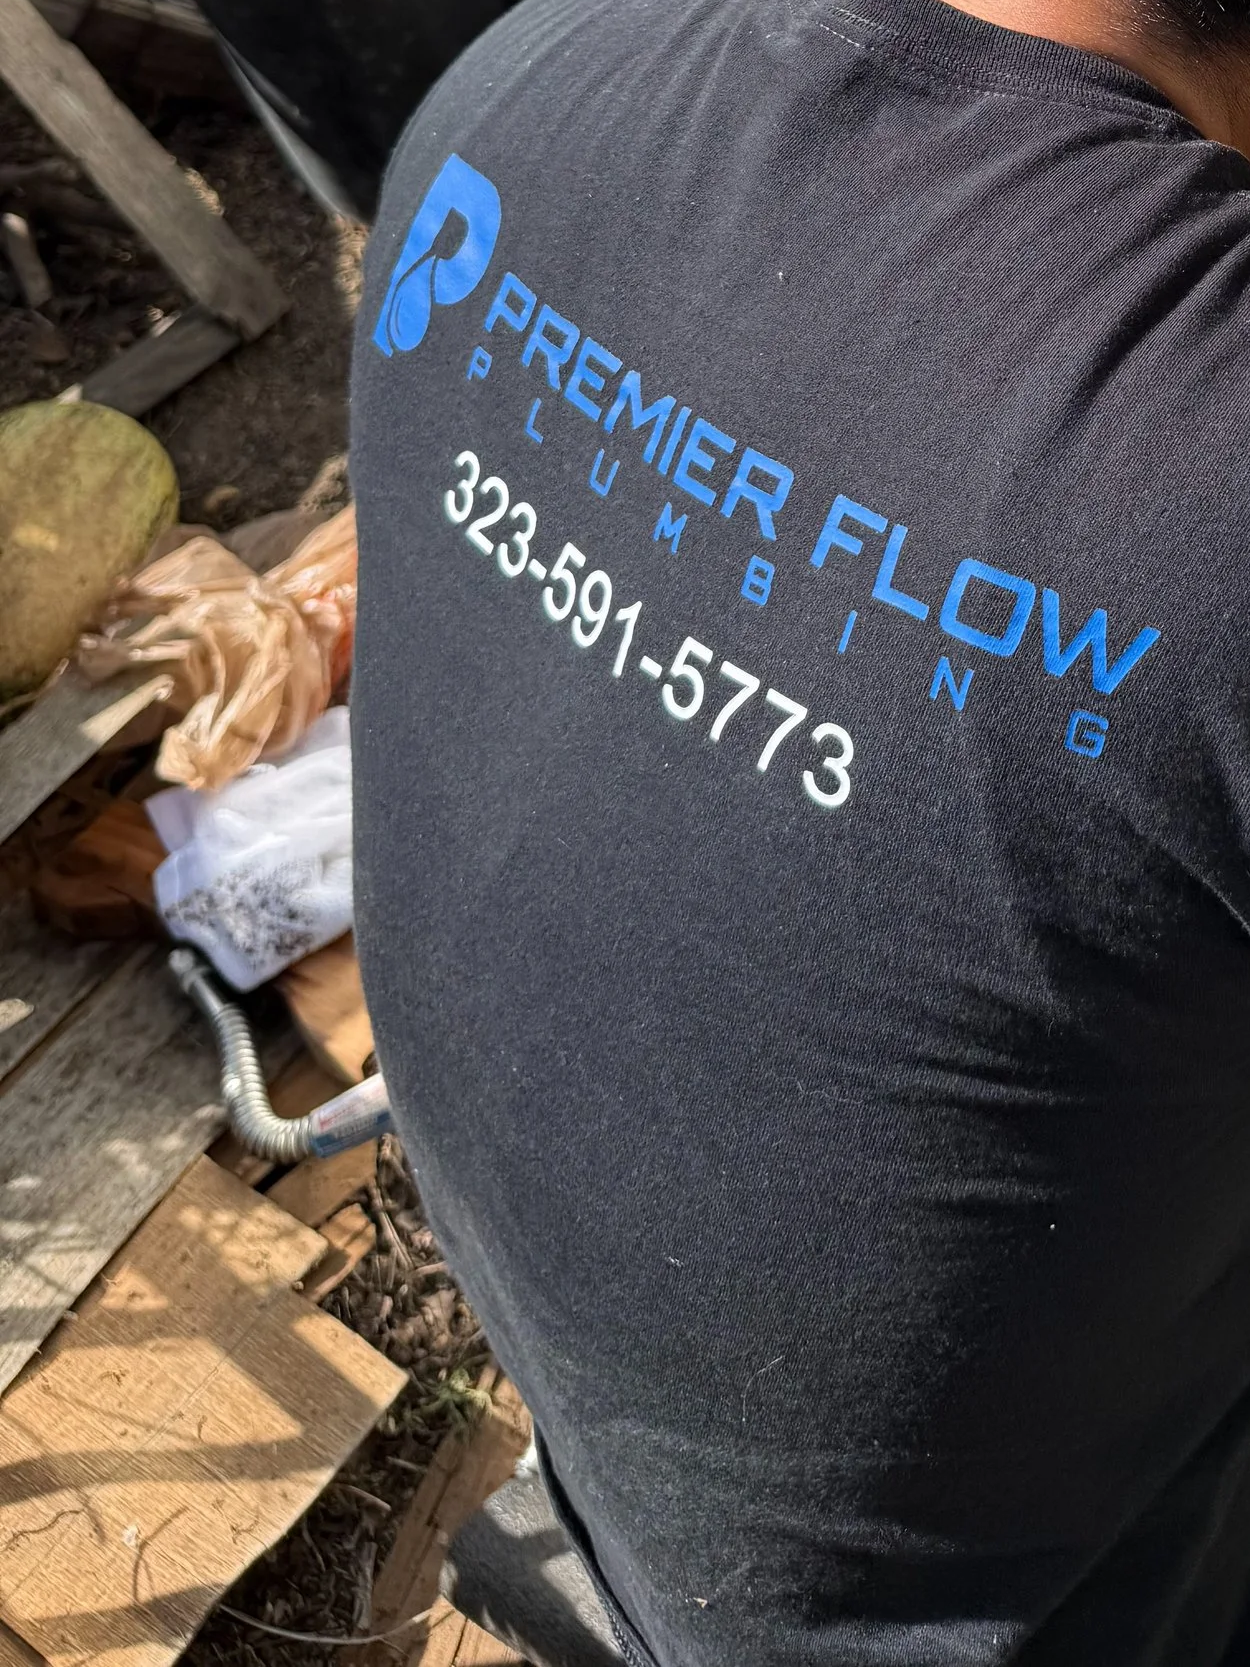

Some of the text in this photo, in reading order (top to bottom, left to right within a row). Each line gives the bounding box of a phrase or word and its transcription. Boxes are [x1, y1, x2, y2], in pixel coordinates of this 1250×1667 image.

[443, 450, 856, 809] 323-591-5773
[467, 346, 1109, 759] PLUMBING
[484, 272, 1161, 696] PREMIER FLOW
